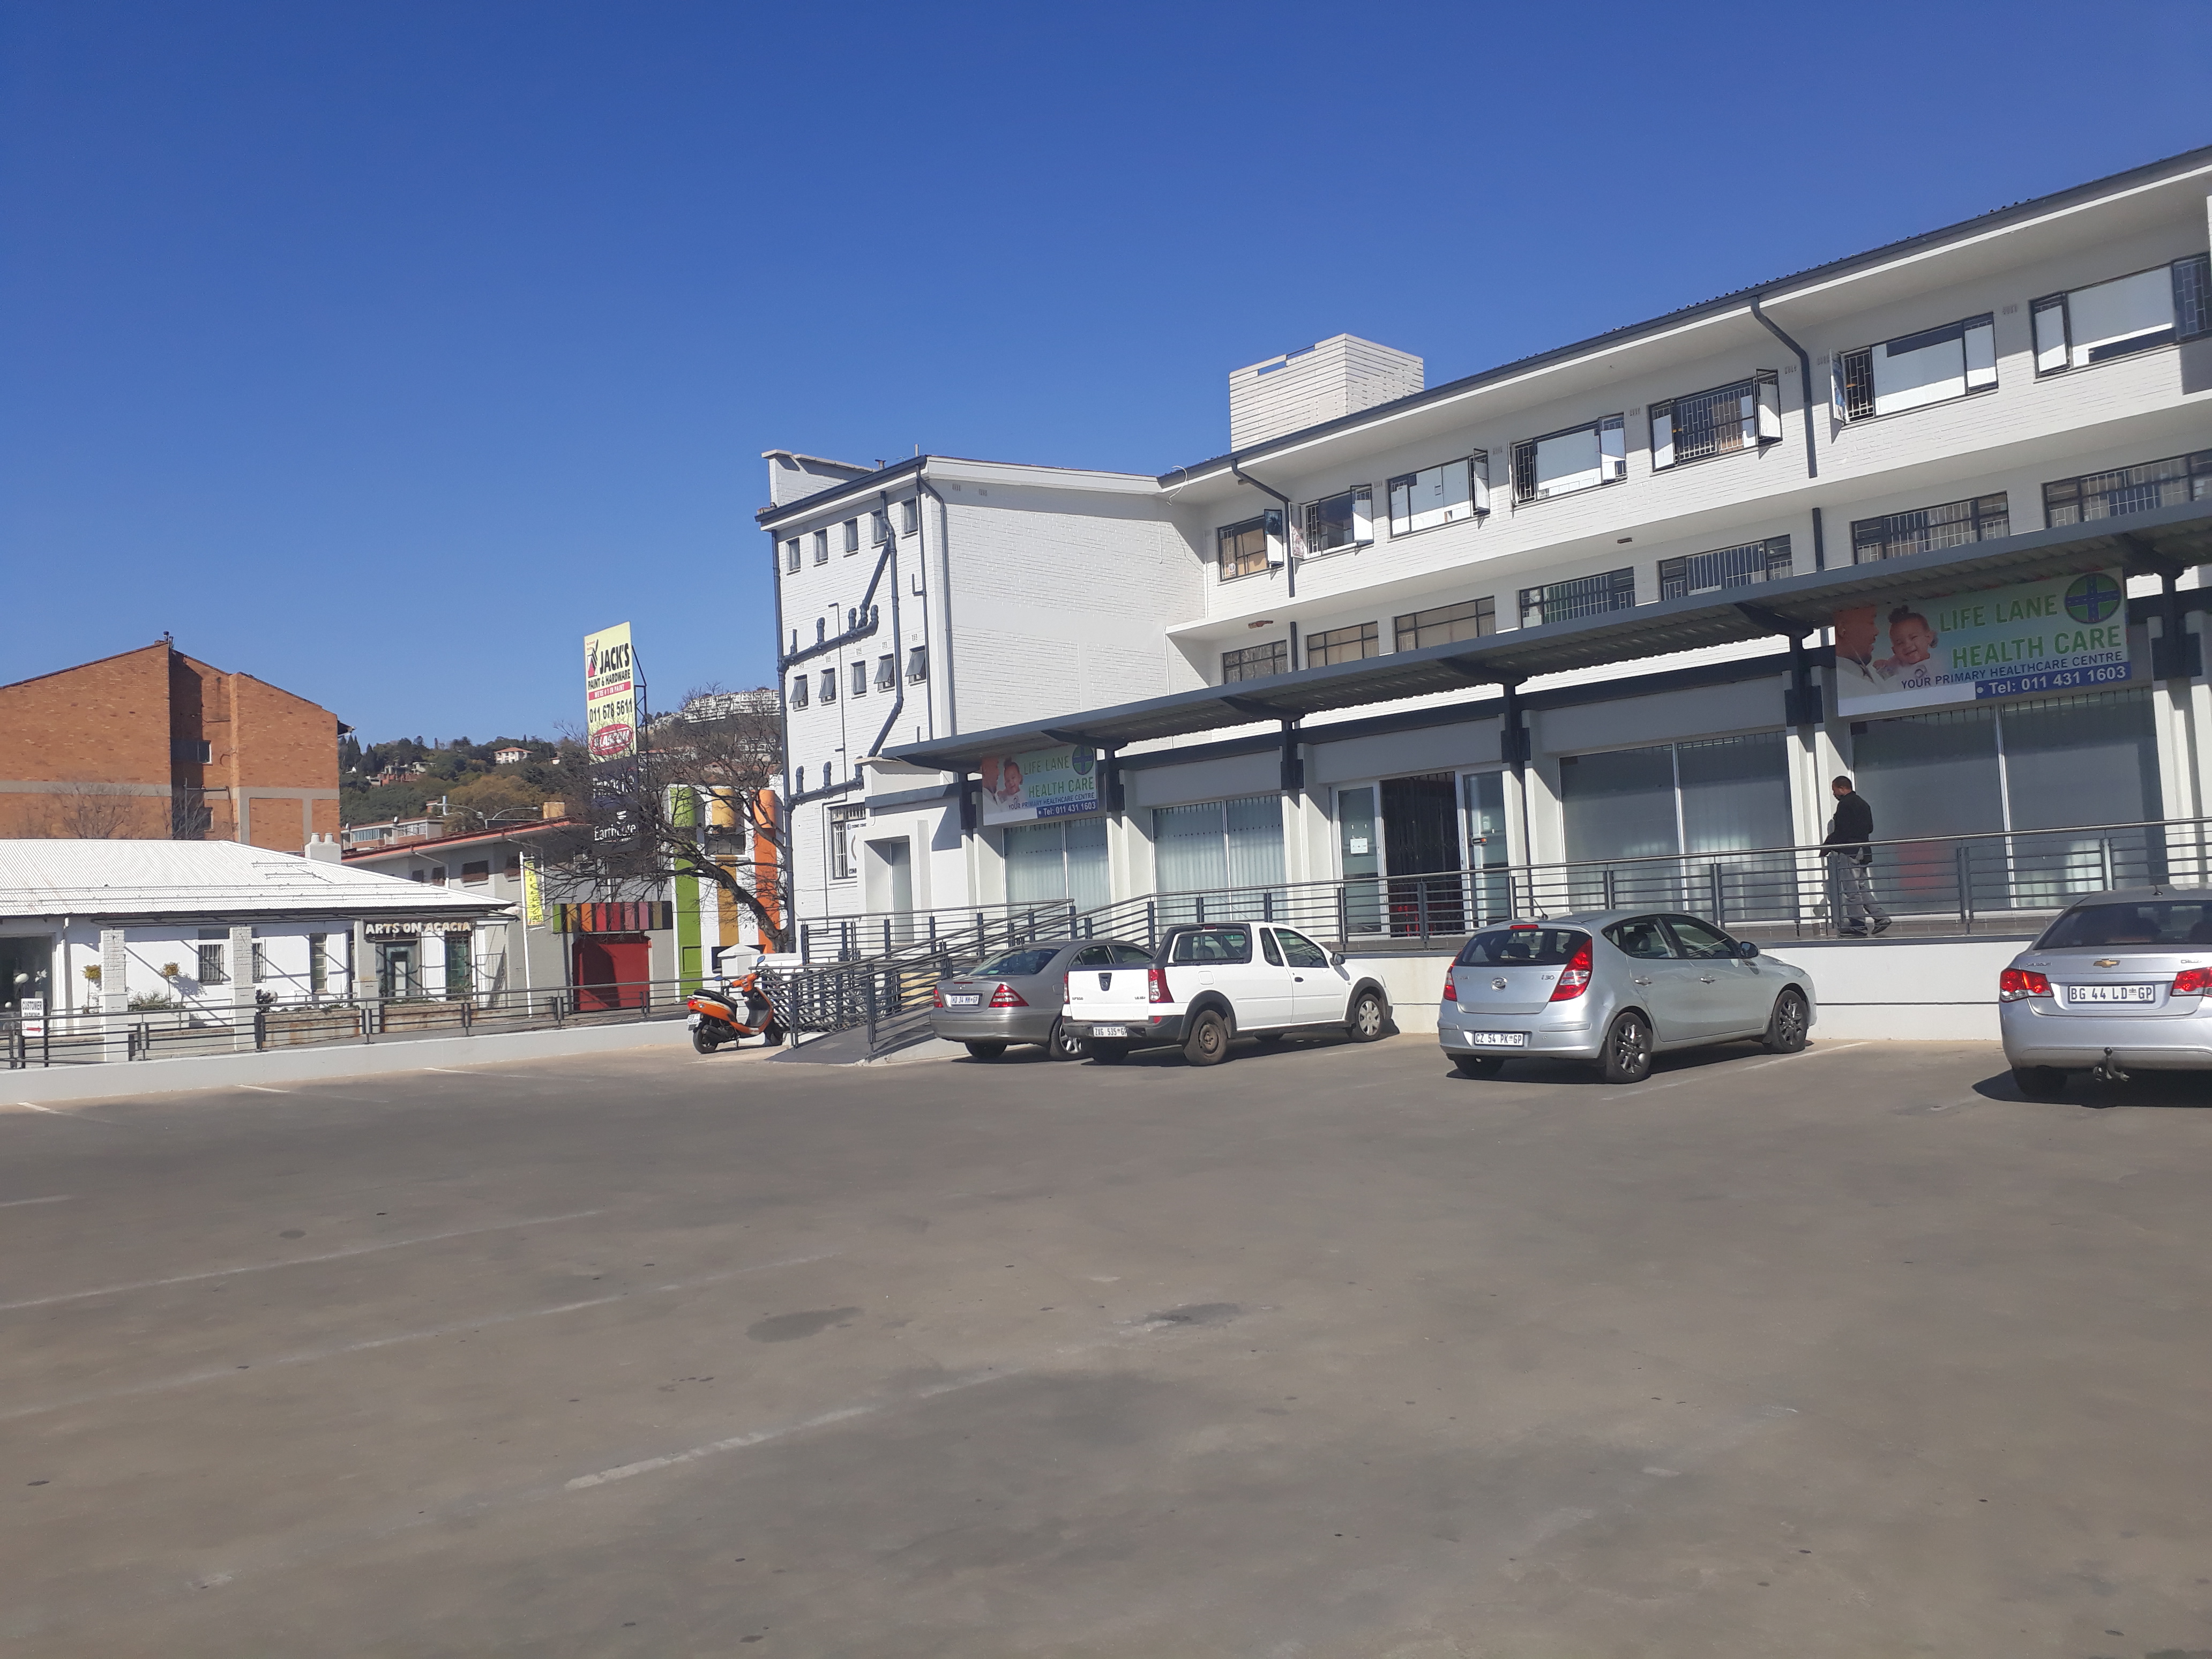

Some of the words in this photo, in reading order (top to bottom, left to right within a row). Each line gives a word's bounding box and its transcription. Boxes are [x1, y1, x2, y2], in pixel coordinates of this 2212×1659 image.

[1939, 605, 1986, 632] LIFE
[1995, 593, 2058, 623] LANE
[1952, 636, 2044, 669] HEALTH
[2054, 625, 2121, 655] CARE
[600, 643, 630, 675] JACK'S
[588, 677, 600, 690] PAINT
[601, 676, 604, 686] &
[606, 669, 631, 685] HARDWARE
[1901, 677, 1931, 690] YOUR
[1935, 669, 1985, 685] PRIMARY
[1990, 658, 2068, 677] HEALTHCARE
[2072, 651, 2123, 666] CENTRE
[1988, 681, 2016, 695] Tel:
[2021, 676, 2047, 691] 011
[2052, 671, 2080, 685] 431
[2087, 666, 2126, 682] 1603
[614, 684, 625, 693] PAINT
[589, 706, 600, 723] 011
[603, 703, 614, 720] 678
[617, 698, 632, 716] 5611
[1023, 761, 1041, 775] LIFE
[1045, 756, 1070, 772] LANE
[1029, 781, 1064, 798] HEALTH
[1068, 776, 1094, 793] CARE
[1008, 802, 1021, 810] YOUR
[1021, 800, 1042, 808] PRIMARY
[1043, 795, 1073, 805] HEALTHCARE
[1074, 792, 1095, 802] CENTRE
[1043, 807, 1055, 816] Tel:
[1056, 805, 1066, 814] 011
[1067, 804, 1079, 812] 431
[1081, 802, 1096, 810] 1603
[365, 923, 400, 934] ARTS
[403, 922, 422, 933] ON
[424, 922, 472, 932] ACACIA
[2071, 988, 2086, 999] BG
[2091, 988, 2106, 999] 44
[2112, 988, 2127, 999] LD
[2138, 987, 2152, 1000] GP
[23, 1001, 42, 1010] CUSTOMER
[1476, 1033, 1484, 1043] CZ
[1488, 1034, 1496, 1043] 54
[1500, 1034, 1508, 1043] PK
[1513, 1035, 1522, 1044] GP
